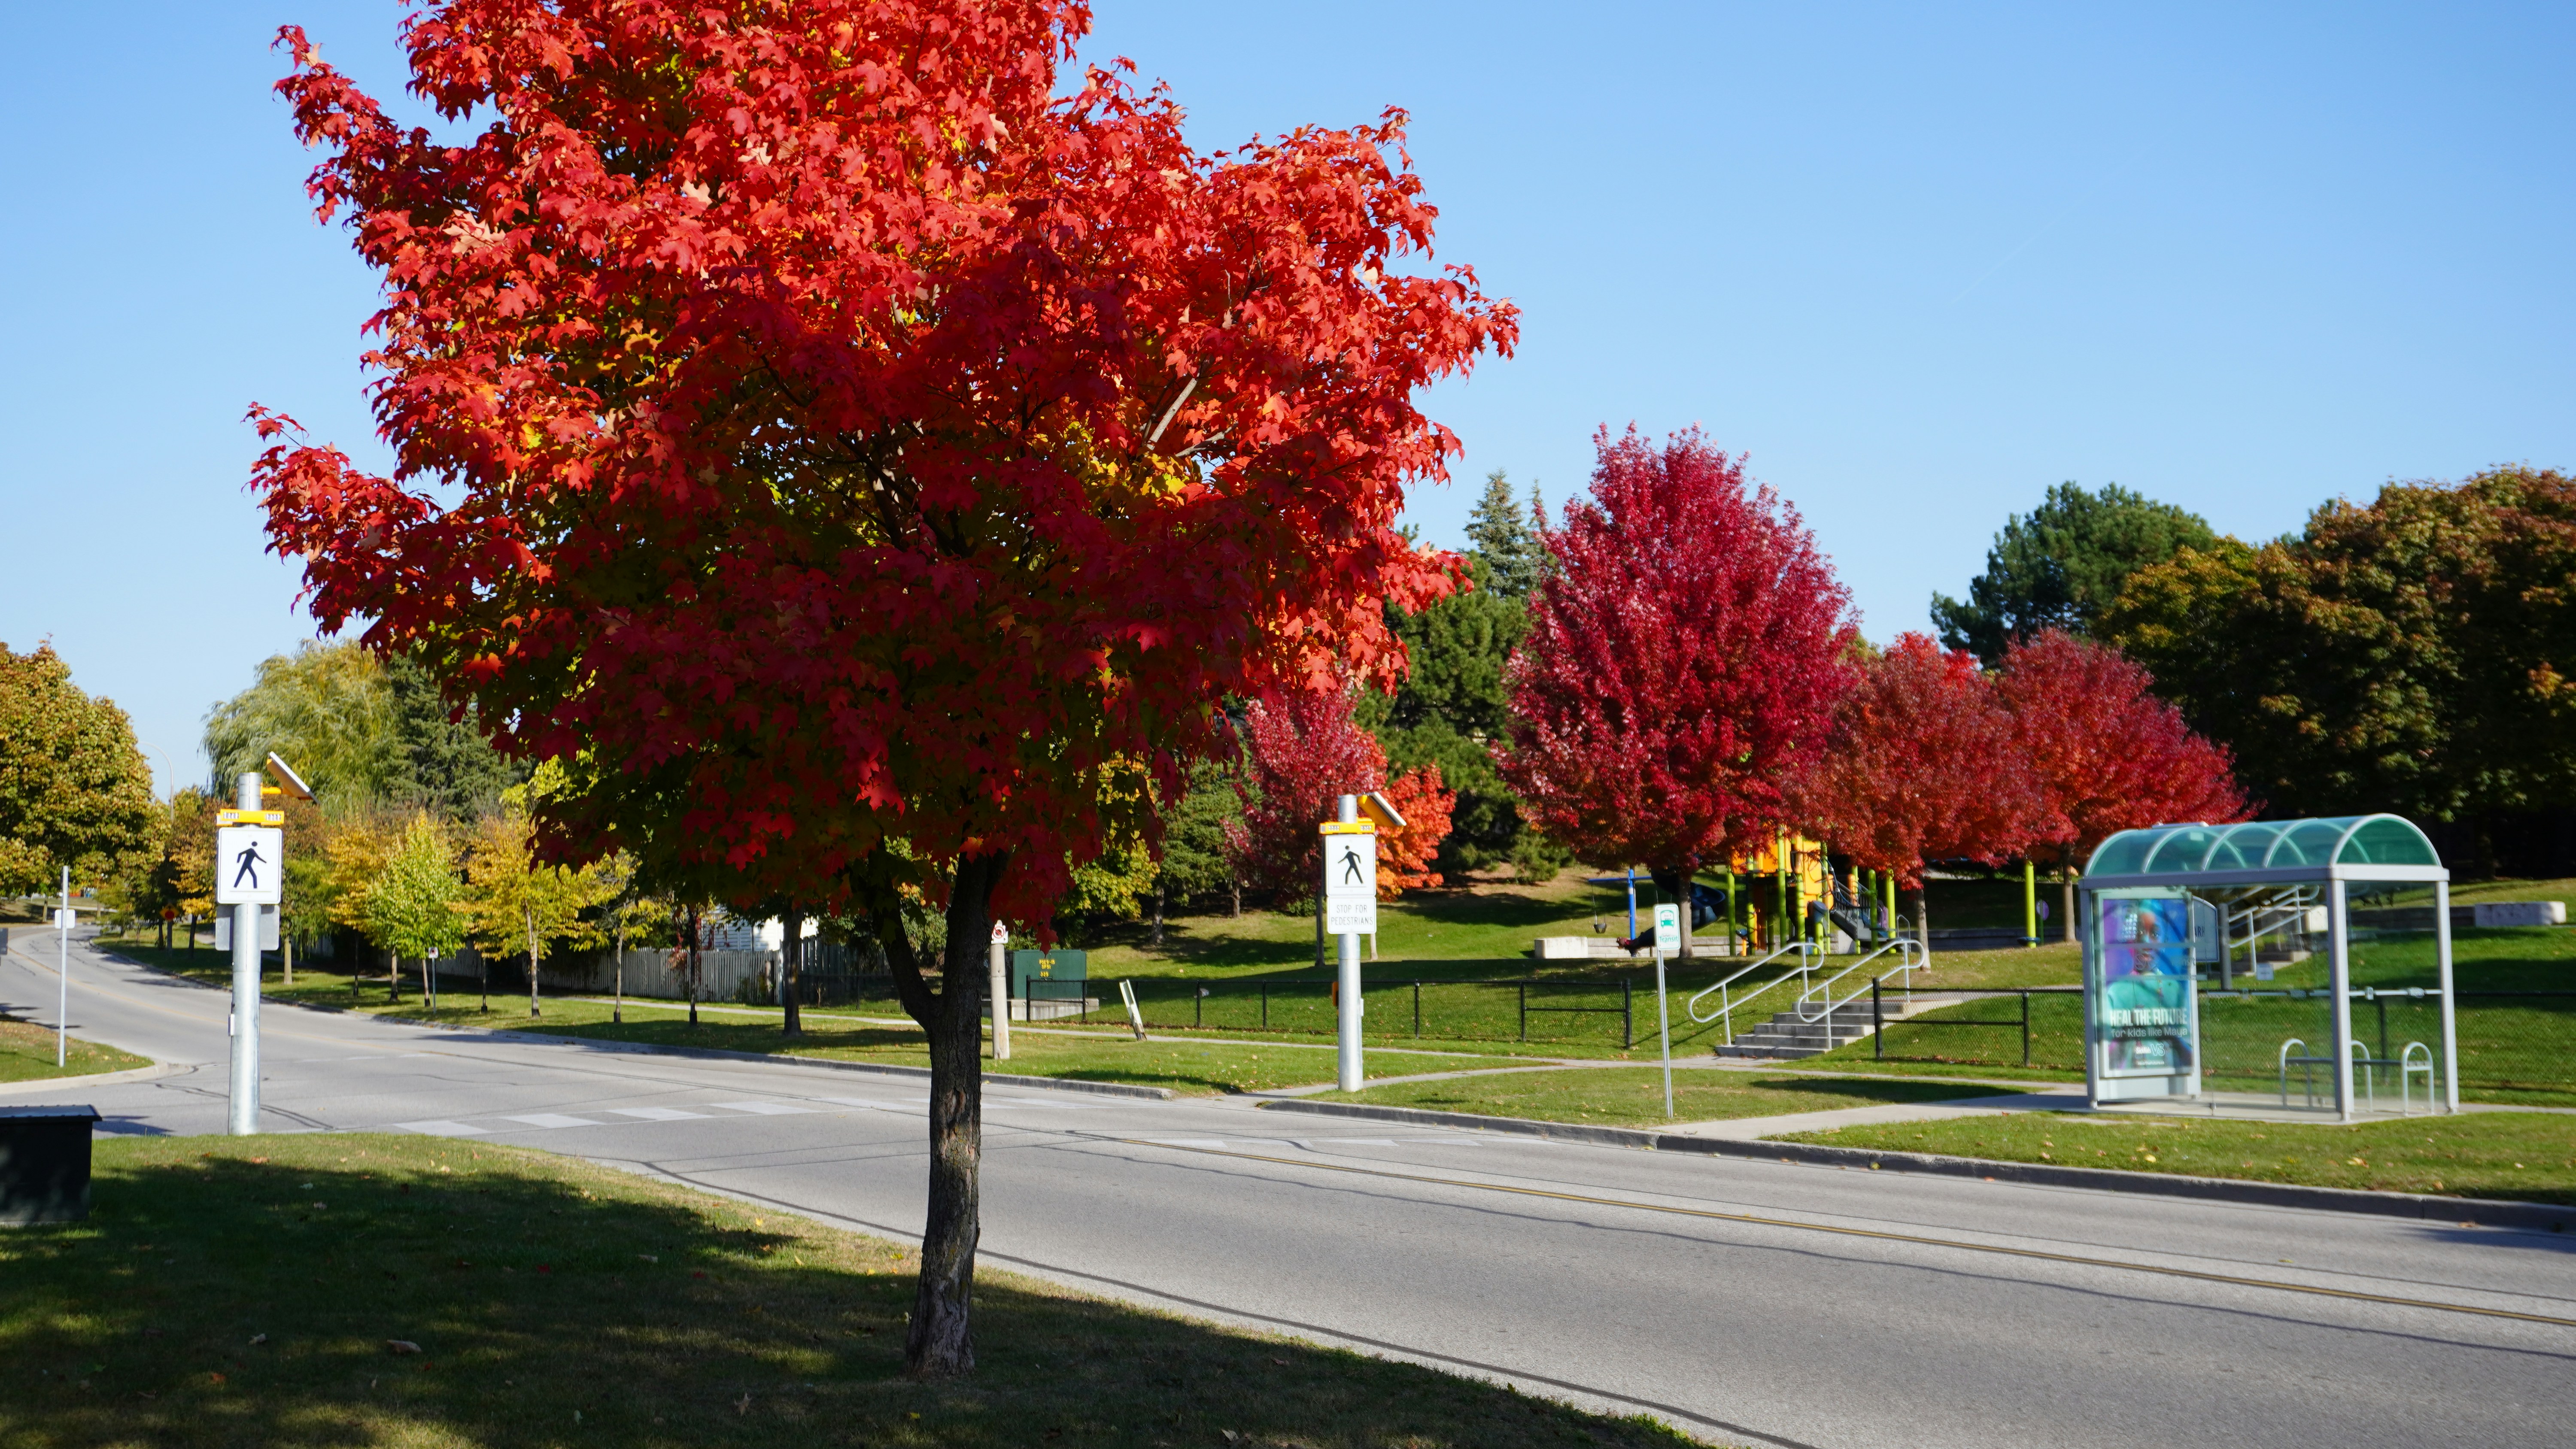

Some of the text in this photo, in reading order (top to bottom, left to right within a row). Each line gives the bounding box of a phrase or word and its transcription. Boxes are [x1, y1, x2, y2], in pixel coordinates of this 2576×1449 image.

[1337, 904, 1367, 913] STOP FOR
[1331, 916, 1373, 925] PEDESTRIANS
[2110, 1009, 2188, 1027] HEAL THE FUTURE
[2111, 1025, 2188, 1038] for kids like Maya
[2151, 1043, 2165, 1057] VS
